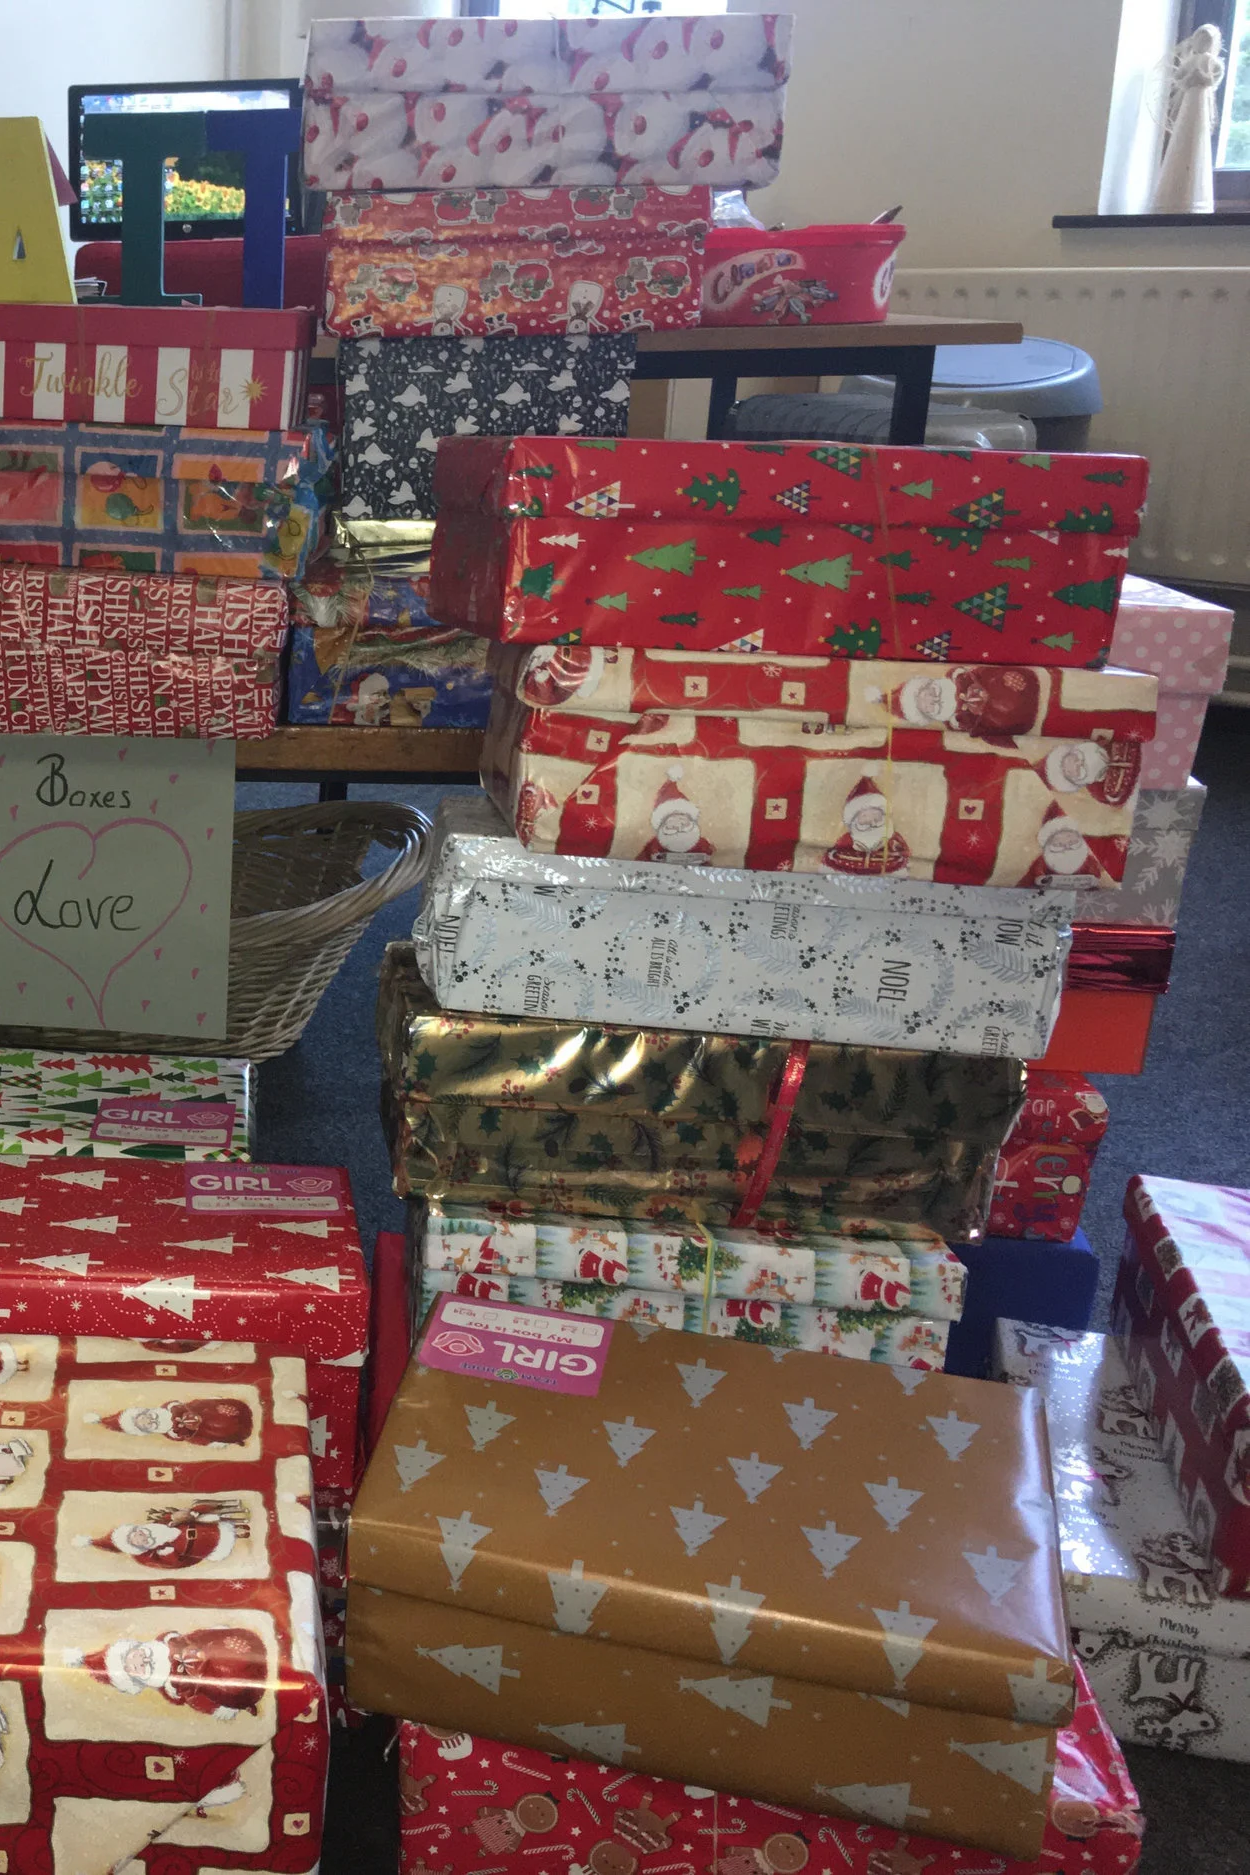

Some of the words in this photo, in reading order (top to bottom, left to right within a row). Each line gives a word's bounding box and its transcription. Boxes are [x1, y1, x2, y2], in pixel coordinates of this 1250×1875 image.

[19, 351, 143, 399] Twinkle
[155, 366, 241, 417] Star
[5, 650, 30, 701] FUN
[36, 753, 131, 809] Boxes
[13, 859, 141, 932] Love
[876, 959, 912, 1003] NOEL
[101, 1108, 181, 1124] GIRL
[189, 1174, 282, 1192] GIRL
[466, 1320, 491, 1330] for
[496, 1325, 508, 1334] is
[512, 1326, 544, 1340] box
[547, 1333, 573, 1345] My
[493, 1340, 598, 1377] GIRL
[1159, 1616, 1200, 1641] Merry
